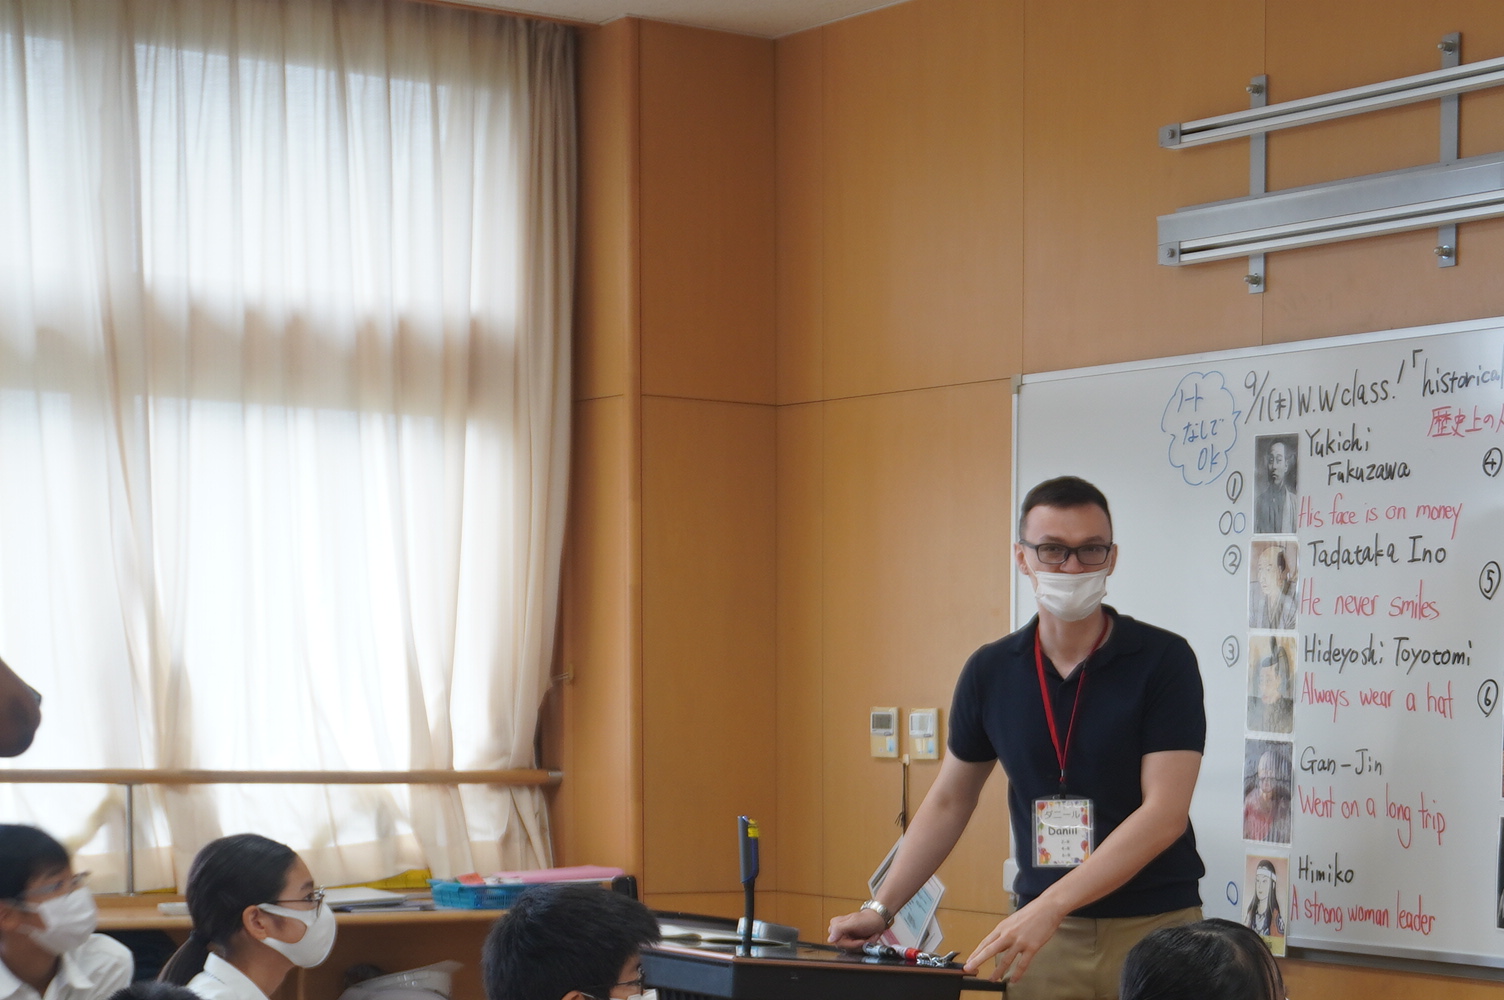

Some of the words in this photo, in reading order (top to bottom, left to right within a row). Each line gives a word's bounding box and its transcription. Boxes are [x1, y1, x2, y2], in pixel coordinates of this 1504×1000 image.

[1182, 418, 1224, 444] なしで
[1305, 423, 1371, 458] Yukichi
[1327, 460, 1411, 486] Fukuzawa
[1298, 495, 1324, 529] His
[1328, 493, 1359, 525] face
[1364, 503, 1378, 523] is
[1385, 505, 1406, 521] on
[1416, 503, 1463, 540] money
[1307, 533, 1399, 570] Tadataka
[1407, 535, 1446, 564] Ino
[1300, 578, 1322, 616] He
[1334, 593, 1379, 616] never
[1388, 579, 1440, 621] smiles
[1304, 633, 1384, 675] Hideyoshi
[1393, 636, 1473, 675] Toyotomi
[1300, 672, 1349, 723] Always
[1359, 687, 1395, 708] wear
[1405, 695, 1417, 712] a
[1426, 680, 1453, 720] hat
[1298, 783, 1335, 819] Went
[1341, 799, 1359, 819] on
[1366, 798, 1376, 818] a
[1385, 782, 1411, 849] long
[1418, 792, 1446, 846] trip
[1298, 852, 1354, 887] Himiko
[1290, 885, 1299, 922] A
[1304, 890, 1343, 931] strong
[1348, 904, 1389, 928] woman
[1397, 890, 1436, 936] leader
